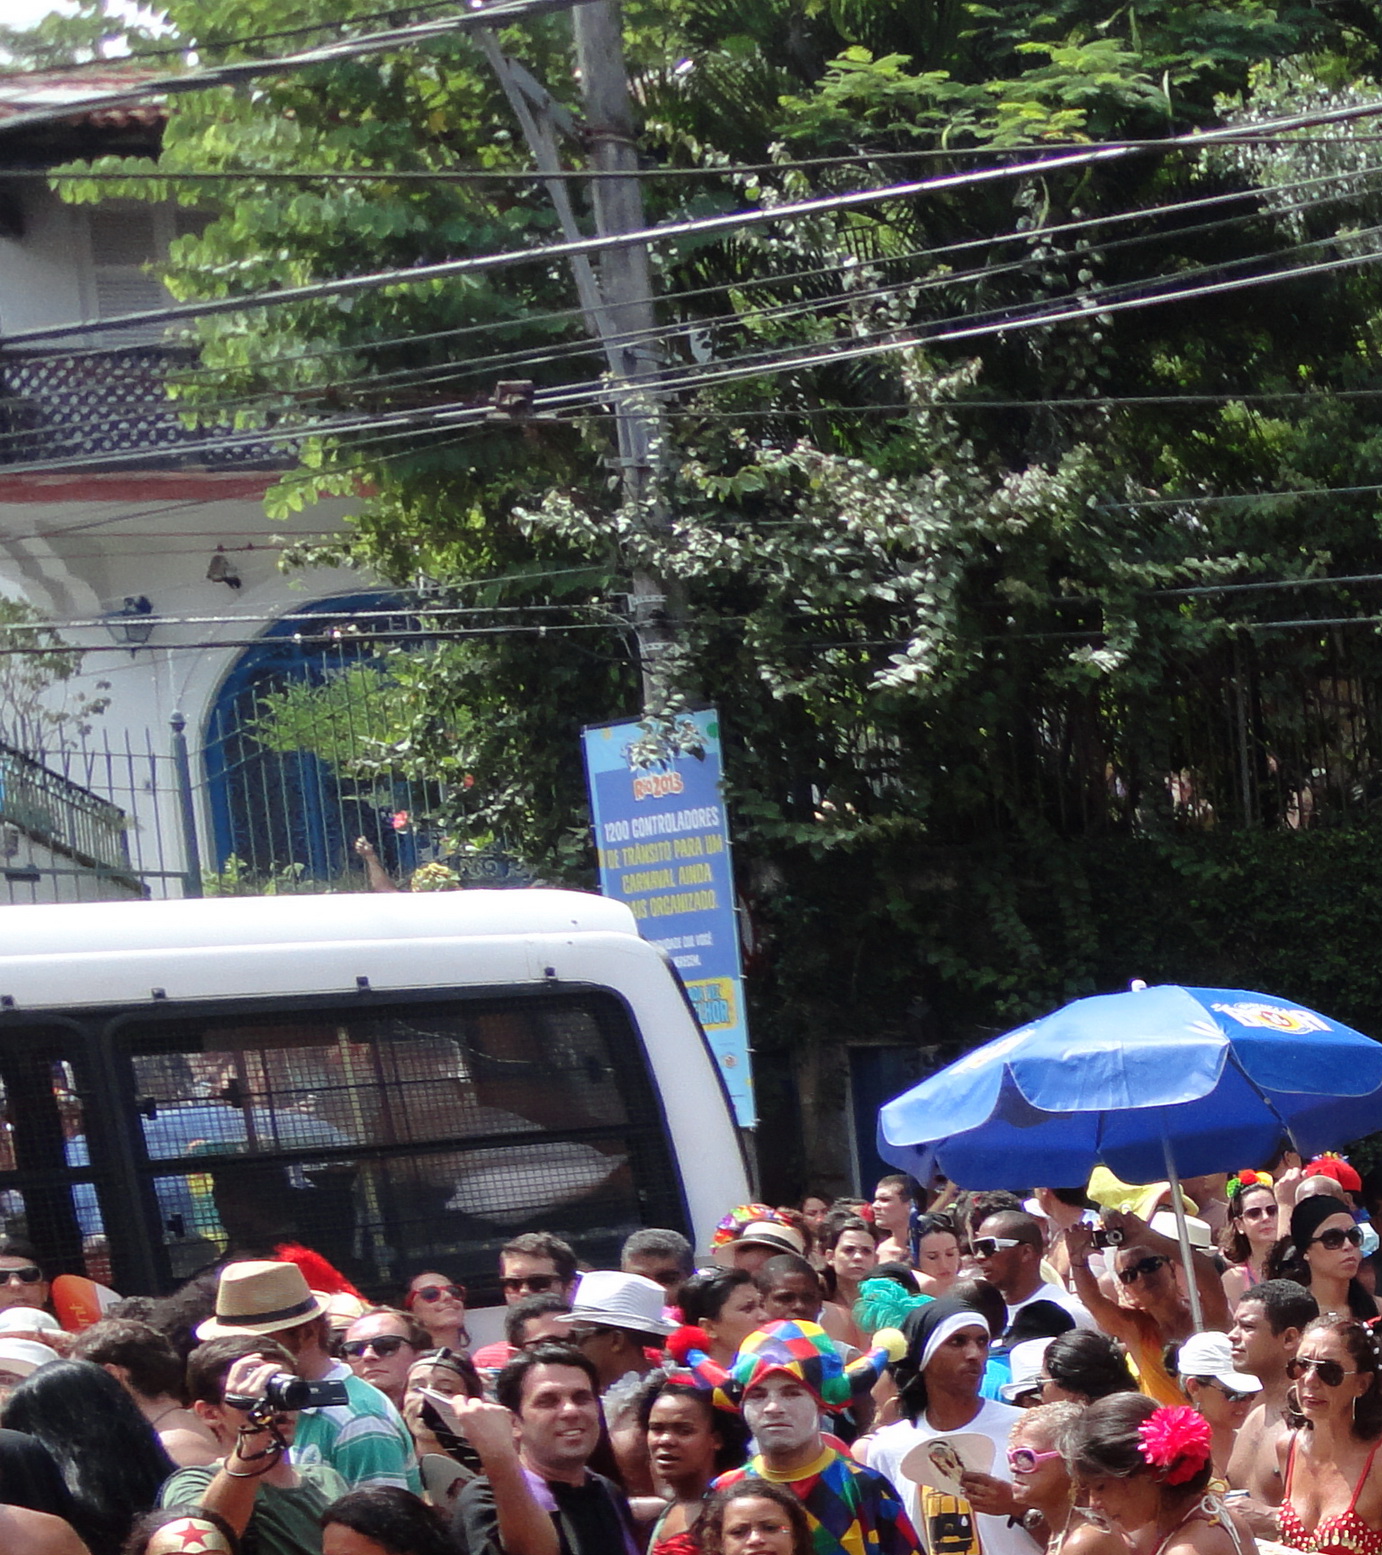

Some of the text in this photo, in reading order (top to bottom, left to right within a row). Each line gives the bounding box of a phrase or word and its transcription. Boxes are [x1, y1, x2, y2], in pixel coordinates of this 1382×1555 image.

[604, 806, 720, 842] 1200 CONTROLADORES
[622, 840, 673, 867] TRÂNSITO
[673, 836, 703, 859] PARA
[704, 834, 723, 854] UM
[621, 863, 713, 894] CARNAVAL AINDA
[626, 898, 648, 919] AIS
